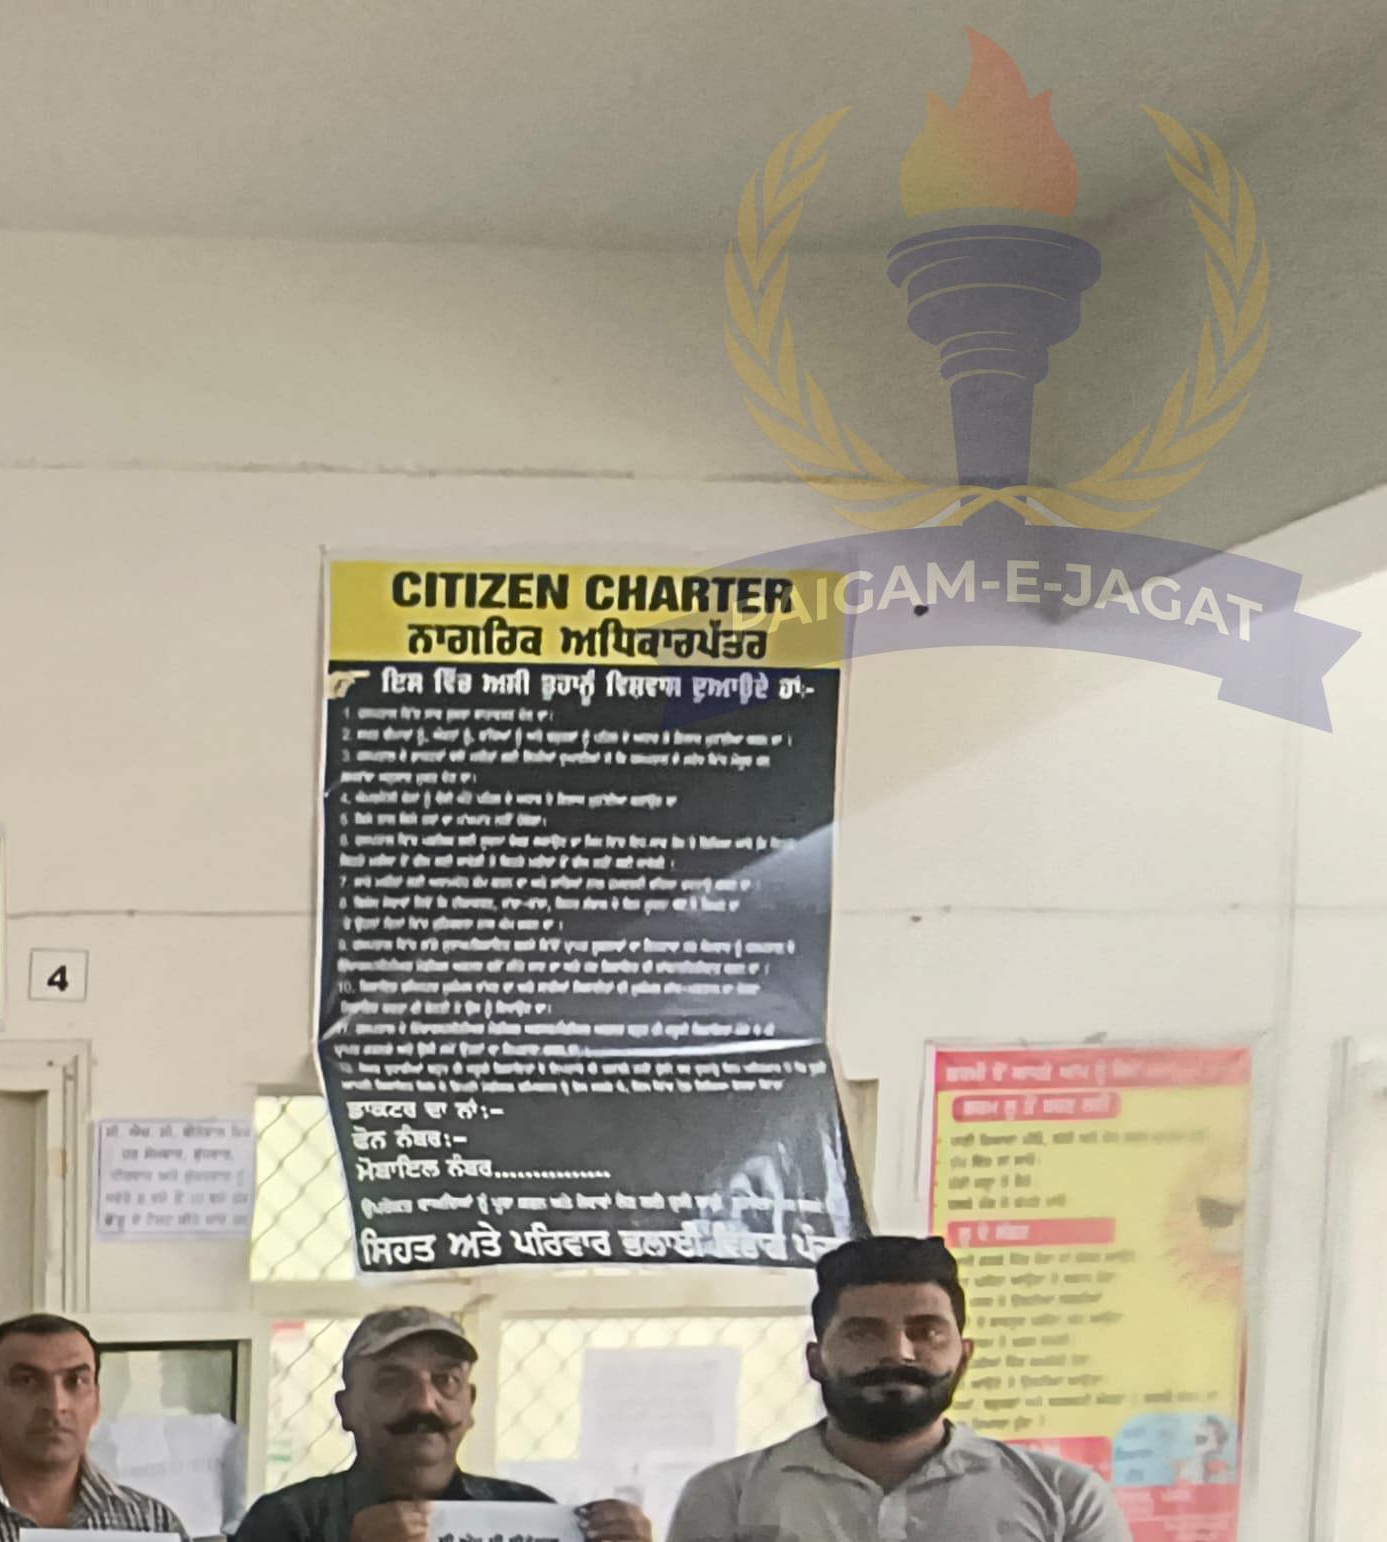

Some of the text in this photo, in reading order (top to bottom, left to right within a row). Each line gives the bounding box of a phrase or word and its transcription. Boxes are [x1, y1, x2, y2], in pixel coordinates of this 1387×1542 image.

[392, 570, 794, 615] CITIZEN CHARTER
[407, 615, 544, 657] ਨਾਗਰਿਕ
[46, 965, 69, 992] 4
[345, 1100, 417, 1120] ਡਾਕਟਰ
[423, 1101, 448, 1119] ਦਾ
[357, 1227, 437, 1267] ਸਿਹਤ
[447, 1220, 502, 1259] ਅਤੇ
[509, 1221, 612, 1257] ਪਰਿਵਾਰ
